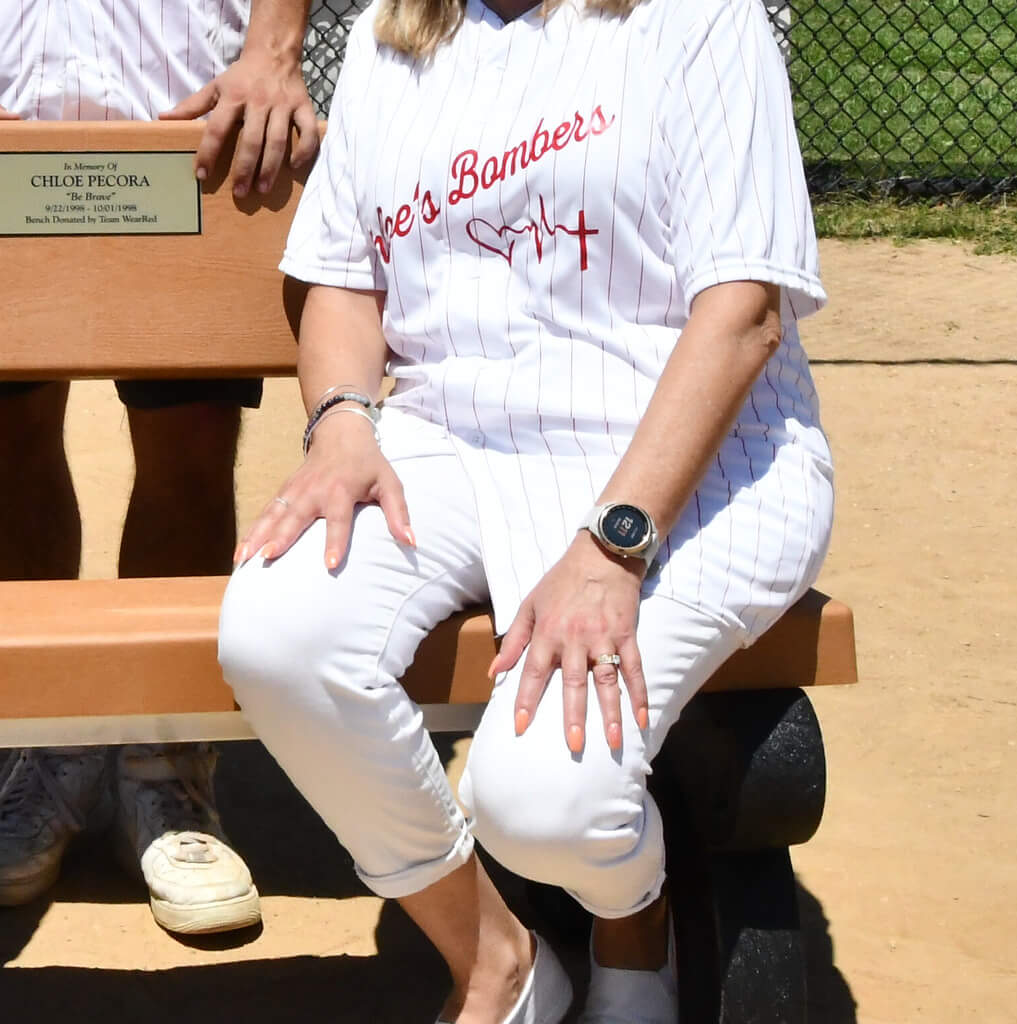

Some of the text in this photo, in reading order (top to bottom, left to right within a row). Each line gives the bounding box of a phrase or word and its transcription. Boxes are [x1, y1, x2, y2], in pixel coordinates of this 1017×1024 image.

[448, 105, 615, 205] Bombers
[64, 161, 118, 172] In Memory Of
[31, 175, 150, 187] CHLOE PECORA
[25, 215, 50, 224] Bench
[52, 215, 85, 224] Donated
[87, 215, 96, 224] by
[99, 215, 120, 223] Team
